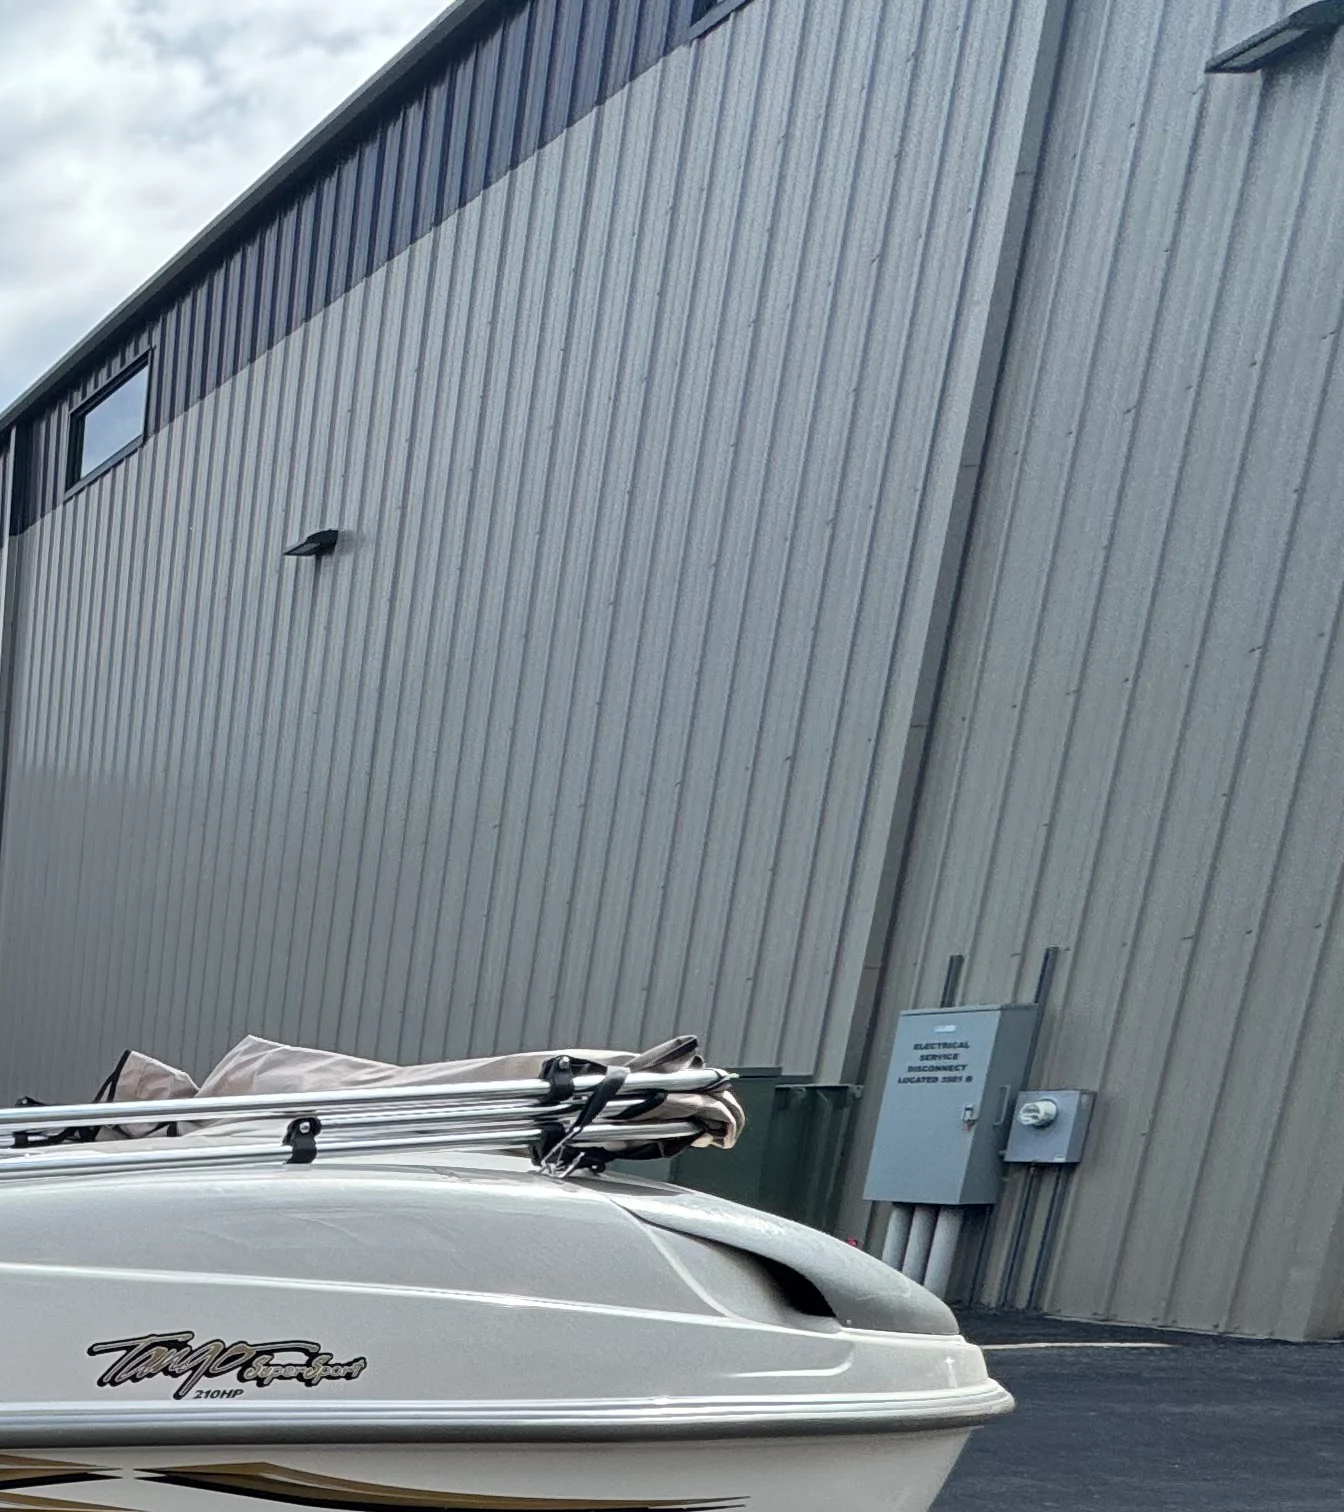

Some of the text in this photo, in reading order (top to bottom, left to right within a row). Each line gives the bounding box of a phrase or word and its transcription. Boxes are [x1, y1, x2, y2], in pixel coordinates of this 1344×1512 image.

[913, 1041, 970, 1051] ELECTRICAL
[919, 1053, 960, 1062] SERVICE
[907, 1064, 968, 1073] DISCONNECT
[897, 1076, 939, 1084] LOCATED
[87, 1331, 321, 1400] Tango
[192, 1389, 245, 1400] 210HP
